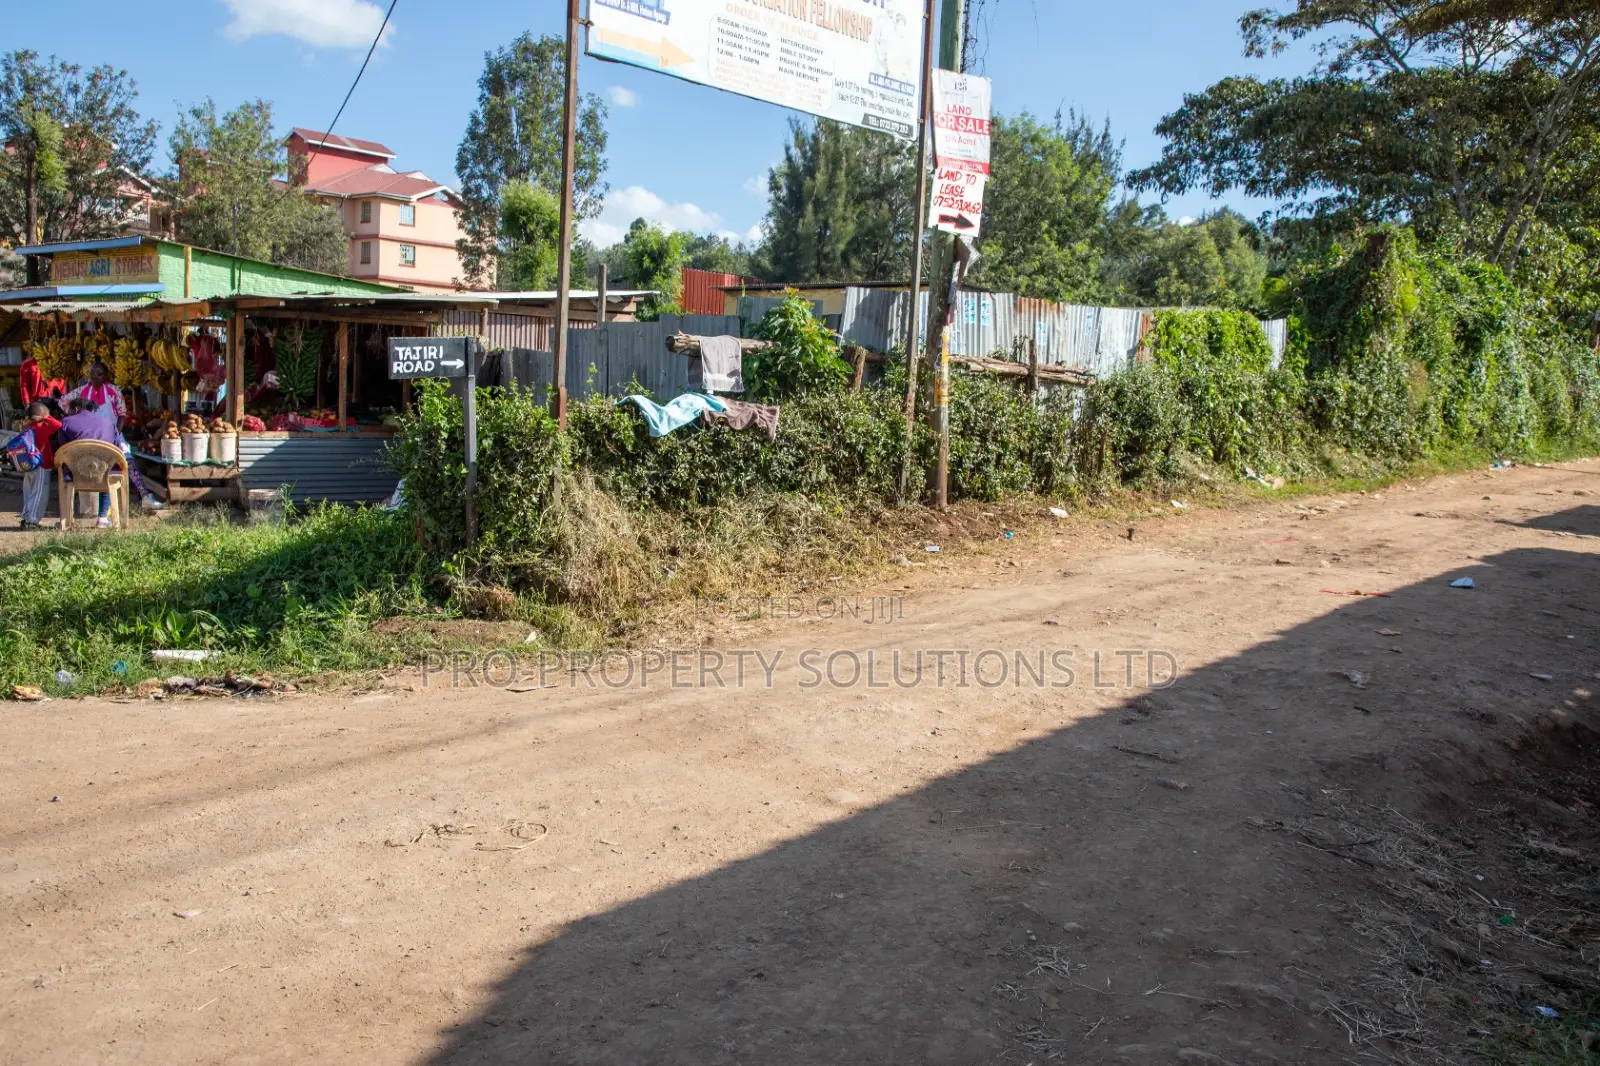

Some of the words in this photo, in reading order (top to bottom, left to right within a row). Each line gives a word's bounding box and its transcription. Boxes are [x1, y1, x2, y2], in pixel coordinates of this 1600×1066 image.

[810, 0, 873, 43] FELLOWSHIP
[946, 104, 972, 116] LAND
[957, 119, 990, 135] SALE
[938, 167, 962, 182] LAND
[966, 173, 977, 185] TO
[940, 183, 965, 197] LEASE
[394, 345, 444, 361] TAJIRI
[392, 360, 435, 374] ROAD
